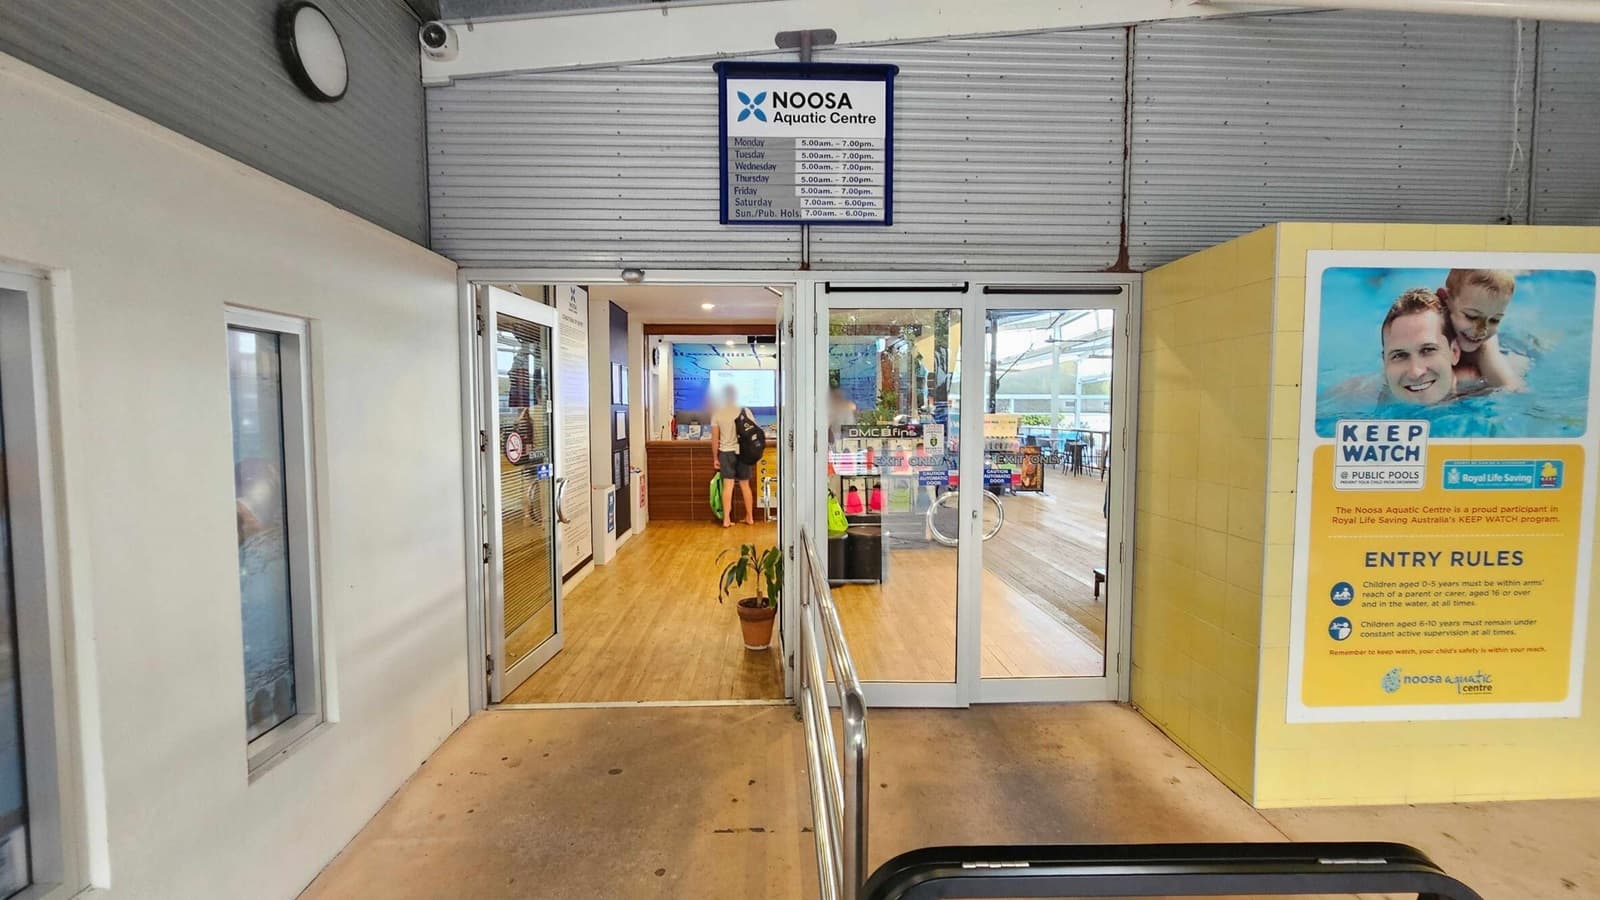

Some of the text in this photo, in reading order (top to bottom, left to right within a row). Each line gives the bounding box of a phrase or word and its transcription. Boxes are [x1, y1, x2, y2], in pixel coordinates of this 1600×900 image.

[772, 92, 853, 109] NOOSA
[773, 112, 877, 126] Aquatic Centre
[734, 138, 765, 148] Monday
[842, 141, 875, 149] 7.00pm.
[735, 151, 765, 160] Tuesday
[842, 153, 875, 162] 7.00pm.
[735, 162, 777, 172] Wednesday
[842, 164, 874, 173] 7.00pm.
[735, 174, 770, 184] Thursday
[841, 177, 874, 185] 7.00pm.
[734, 186, 758, 196] Friday
[841, 189, 873, 197] 7.00pm.
[735, 198, 773, 208] Saturday
[844, 200, 877, 209] 6.00pm.
[735, 209, 777, 219] Sun./Pub.
[845, 211, 878, 219] 6.00pm.
[848, 428, 881, 437] DMC
[1343, 425, 1423, 442] KEEP
[1342, 445, 1420, 462] WATCH
[875, 456, 945, 467] EXIT ONLY
[996, 455, 1061, 464] EXIT ONLY
[1352, 471, 1385, 479] PUBLIC
[1389, 471, 1419, 479] POOLS
[1462, 474, 1486, 484] Royal
[1488, 474, 1502, 483] Life
[1504, 474, 1532, 484] Saving
[1336, 506, 1352, 514] The
[1355, 506, 1383, 514] Noosa
[1386, 506, 1419, 515] Aquatic
[1455, 505, 1461, 513] is
[1472, 505, 1498, 514] proud
[1501, 505, 1547, 514] participant
[1333, 516, 1356, 525] Royal
[1360, 516, 1376, 524] Life
[1379, 516, 1408, 525] Saving
[1412, 516, 1456, 524] Australia's
[1521, 516, 1560, 524] program.
[1365, 550, 1525, 568] ENTRY RULES
[1399, 581, 1419, 589] aged
[1405, 591, 1431, 599] parent
[1469, 590, 1489, 598] aged
[1397, 621, 1417, 629] aged
[1459, 647, 1479, 655] safety
[1404, 675, 1442, 685] noosa
[1463, 684, 1493, 693] centre
